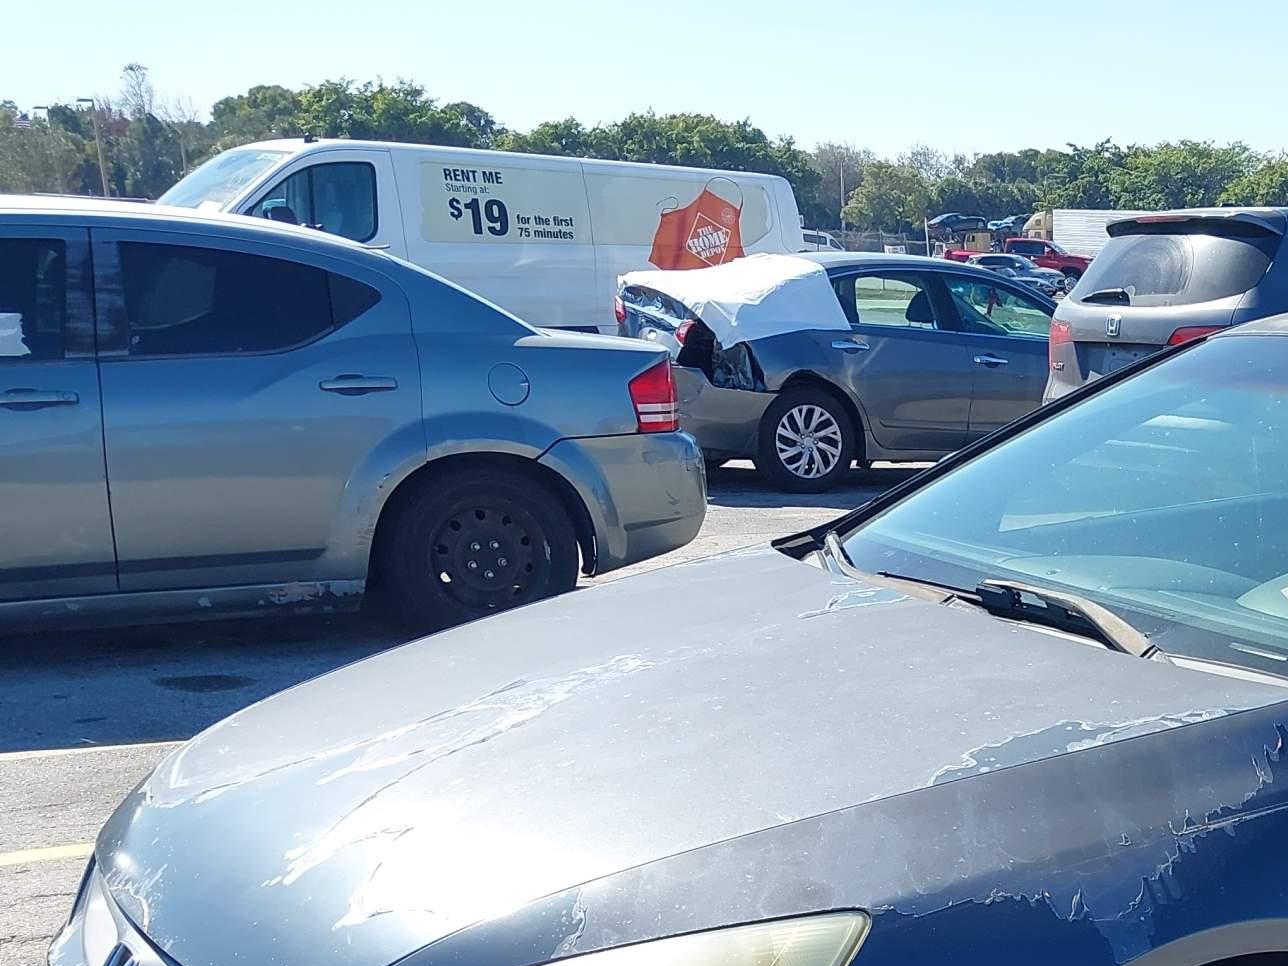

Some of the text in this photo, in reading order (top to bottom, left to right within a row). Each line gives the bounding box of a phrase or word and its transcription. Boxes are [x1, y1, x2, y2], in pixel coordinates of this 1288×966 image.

[443, 168, 503, 185] RENT ME
[445, 183, 490, 195] Starting at:
[448, 197, 509, 237] $19
[516, 214, 574, 227] for the first
[517, 227, 574, 240] 75 minutes
[697, 225, 715, 236] THE
[687, 230, 729, 253] HOME
[700, 244, 725, 258] DEPOT
